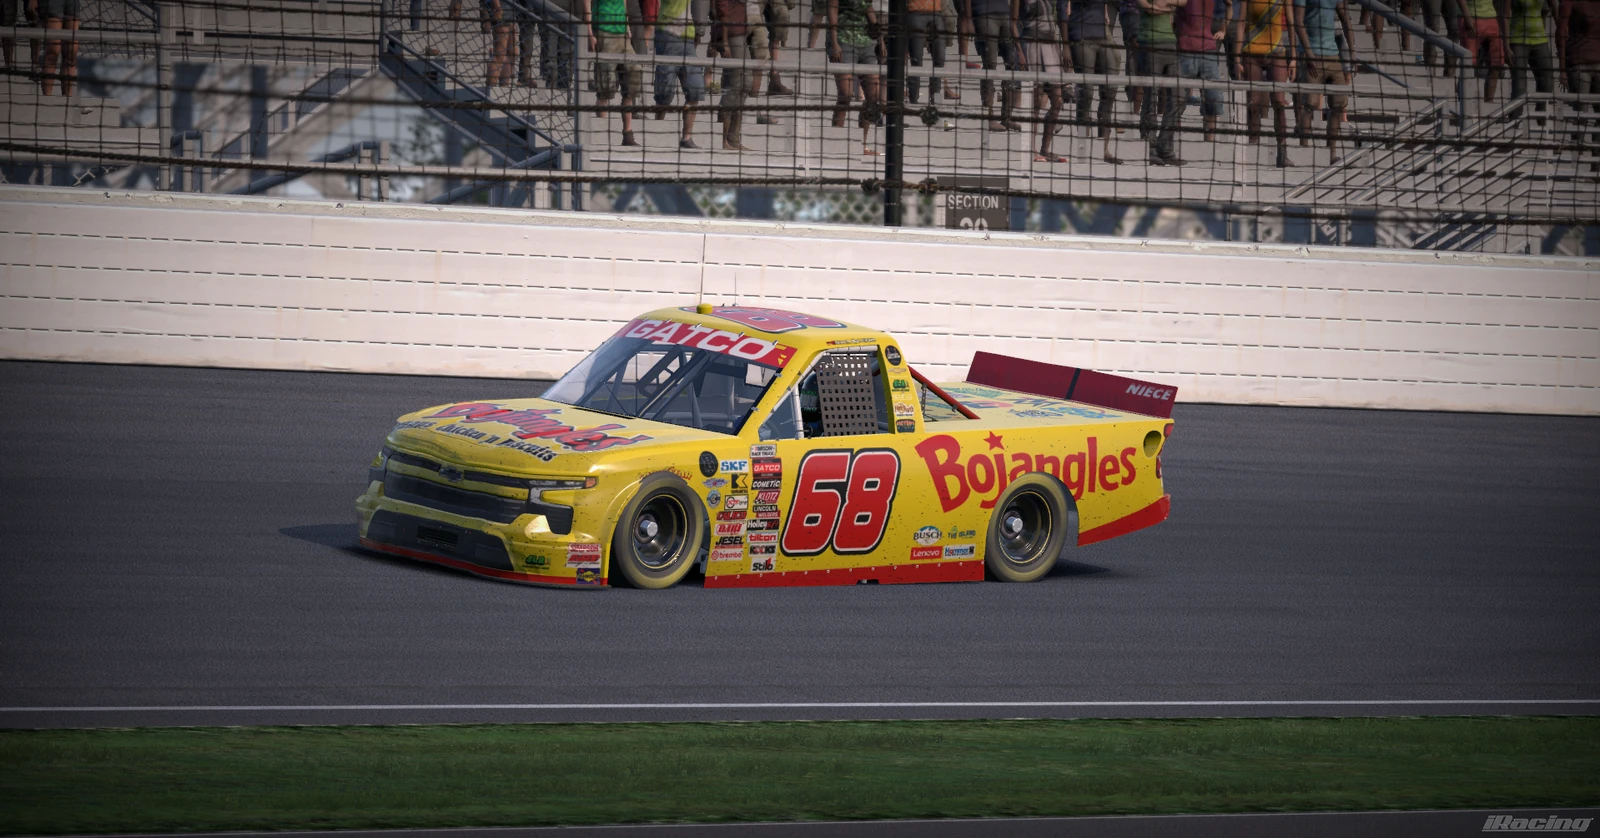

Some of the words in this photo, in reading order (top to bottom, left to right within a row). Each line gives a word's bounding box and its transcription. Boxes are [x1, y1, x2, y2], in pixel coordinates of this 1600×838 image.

[947, 194, 999, 210] SECTION
[625, 318, 776, 361] GATCO
[1125, 383, 1173, 401] NIECE
[720, 461, 748, 471] SKF
[753, 464, 781, 472] GATCO
[757, 491, 779, 501] KLOTZ
[780, 447, 902, 558] 68
[747, 519, 768, 531] Holley
[715, 536, 744, 546] JESEL
[749, 533, 777, 541] tilton
[913, 530, 943, 541] BUSCH
[912, 549, 940, 558] Lenovo
[752, 557, 774, 571] Stilo
